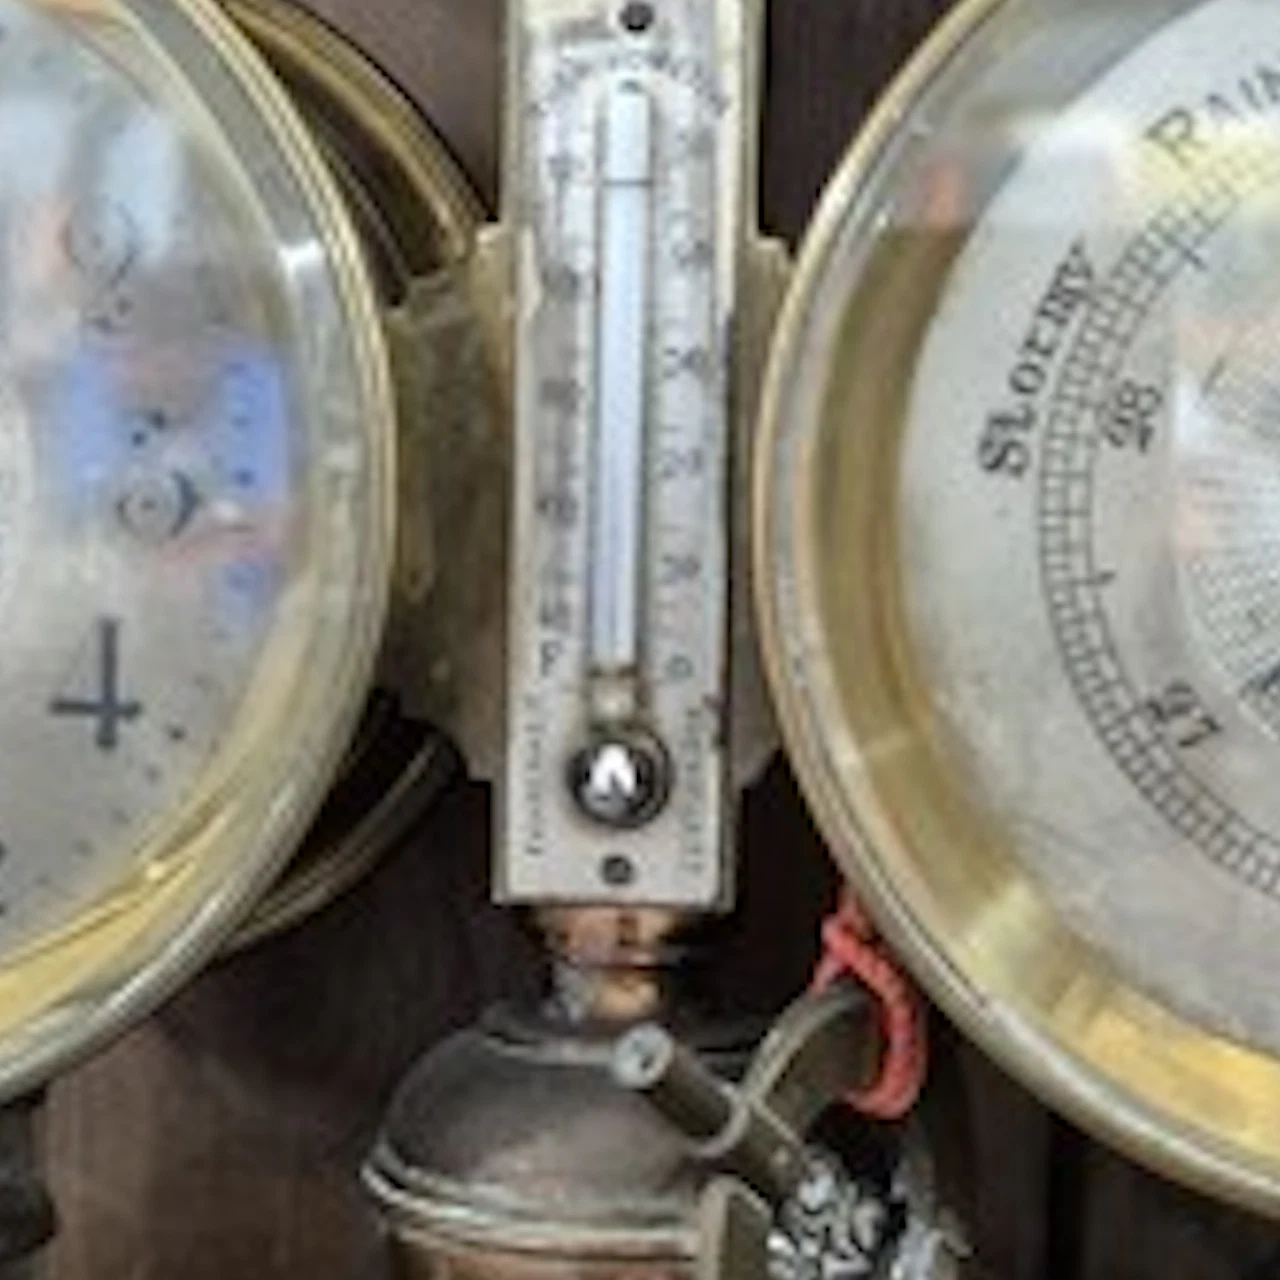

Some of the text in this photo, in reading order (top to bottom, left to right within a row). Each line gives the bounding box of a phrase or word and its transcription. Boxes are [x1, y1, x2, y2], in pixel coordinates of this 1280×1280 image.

[1096, 378, 1164, 454] 28
[117, 408, 200, 538] 3
[47, 617, 144, 751] 4
[1143, 677, 1225, 751] 27
